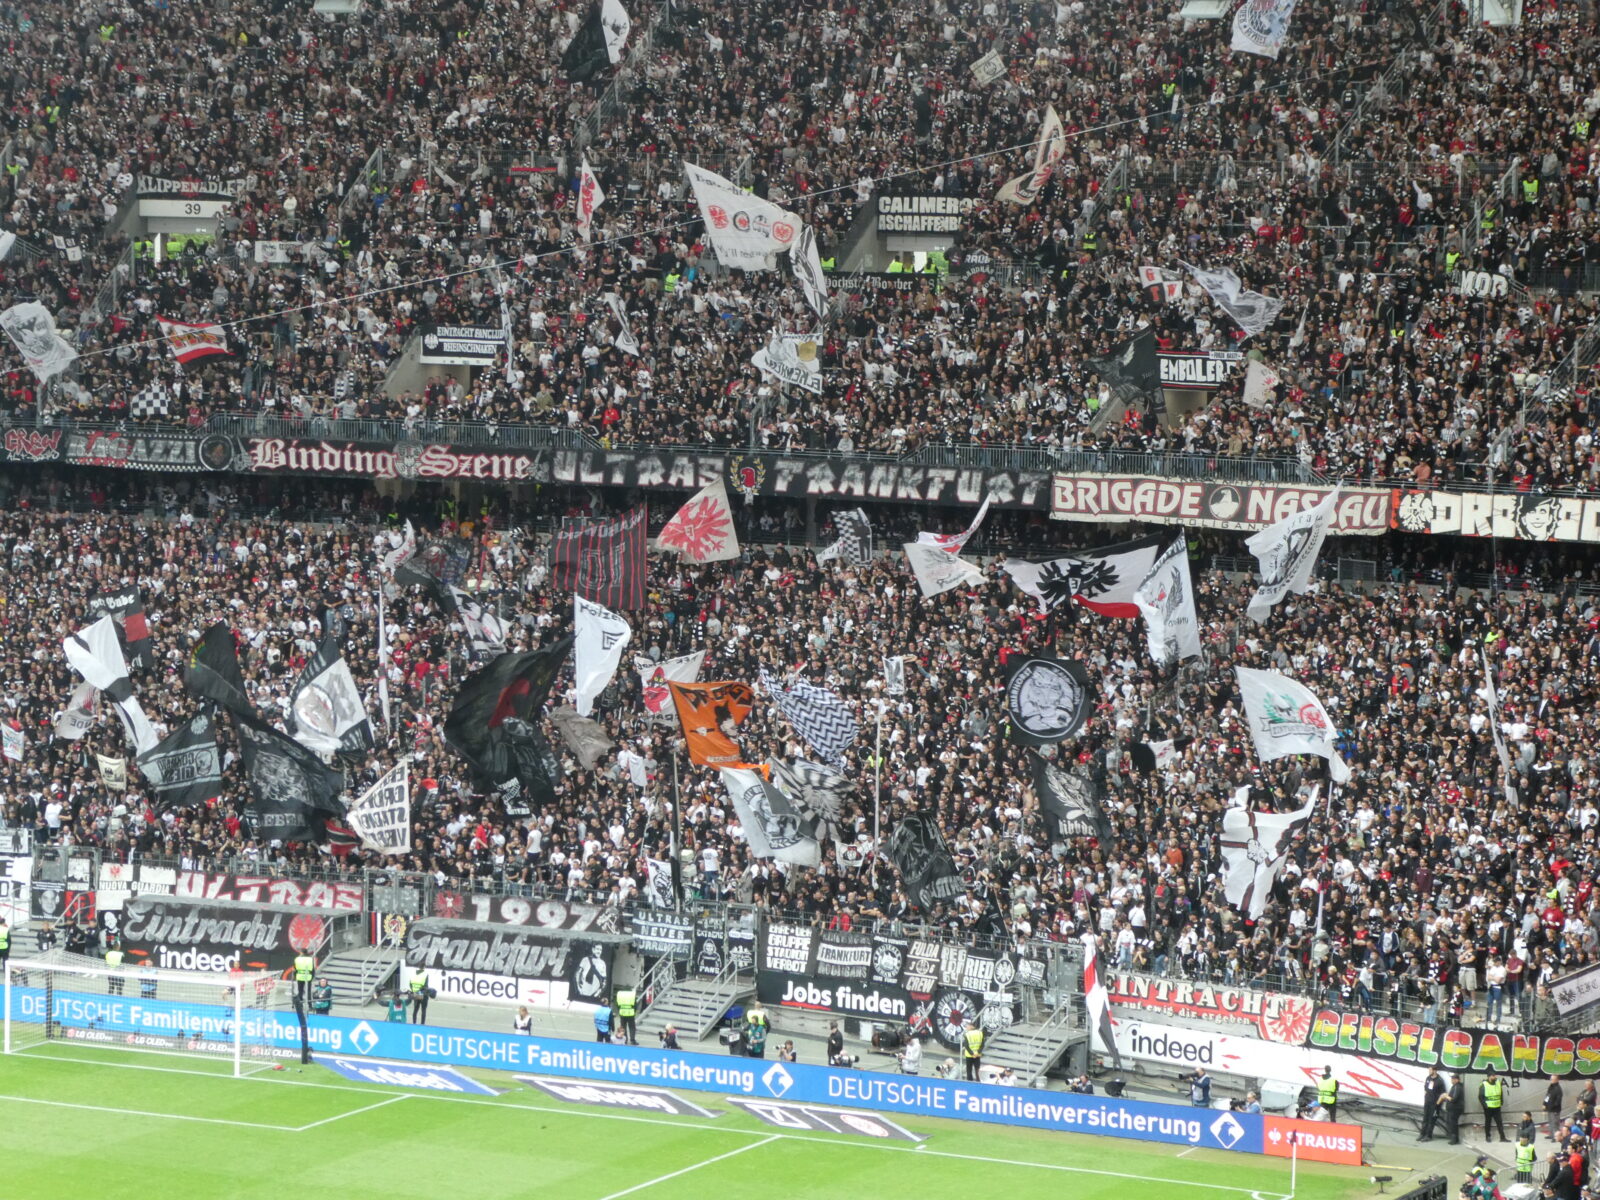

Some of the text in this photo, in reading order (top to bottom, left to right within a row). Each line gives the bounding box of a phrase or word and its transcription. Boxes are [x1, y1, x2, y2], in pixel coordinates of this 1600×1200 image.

[184, 203, 201, 215] 39
[437, 326, 475, 338] EINTRACHT
[443, 342, 497, 354] RHEINSCHNAKEN
[4, 428, 63, 456] CREW
[66, 433, 197, 463] RAGAZZI
[248, 437, 532, 482] Binding Szene
[552, 451, 1050, 504] ULTRAS FRANKFURT
[1054, 478, 1203, 516] BRIGADE
[99, 880, 170, 895] NUOVA GUARDIA
[176, 871, 364, 912] ULTRAS
[123, 901, 283, 950] Eintracht
[471, 894, 600, 932] 1997
[638, 911, 690, 926] ULTRAS
[640, 925, 685, 939] NEVER
[767, 933, 811, 951] GRUPPE
[159, 944, 241, 972] indeed
[405, 924, 572, 978] Frankfurt
[766, 946, 810, 962] STADION
[820, 947, 871, 963] FRANKFURT
[910, 941, 940, 959] FULDA
[766, 957, 808, 973] VERBOT
[817, 962, 868, 978] HOOLIGANS
[965, 958, 995, 979] RIED
[441, 970, 519, 1000] indeed
[905, 976, 935, 993] CREW
[963, 976, 992, 992] GEBIET
[1104, 972, 1286, 1019] EINTRACHT
[21, 995, 124, 1024] DEUTSCHE
[782, 979, 906, 1017] Jobs finden
[1122, 1000, 1142, 1010] auf
[1147, 1004, 1174, 1017] ewig
[1201, 1012, 1250, 1025] ergeben
[1130, 1028, 1213, 1065] indeed
[410, 1032, 754, 1092] DEUTSCHE Familienversicherung
[828, 1075, 1201, 1142] DEUTSCHE Familienversicherung
[1285, 1130, 1357, 1153] STRAUSS
